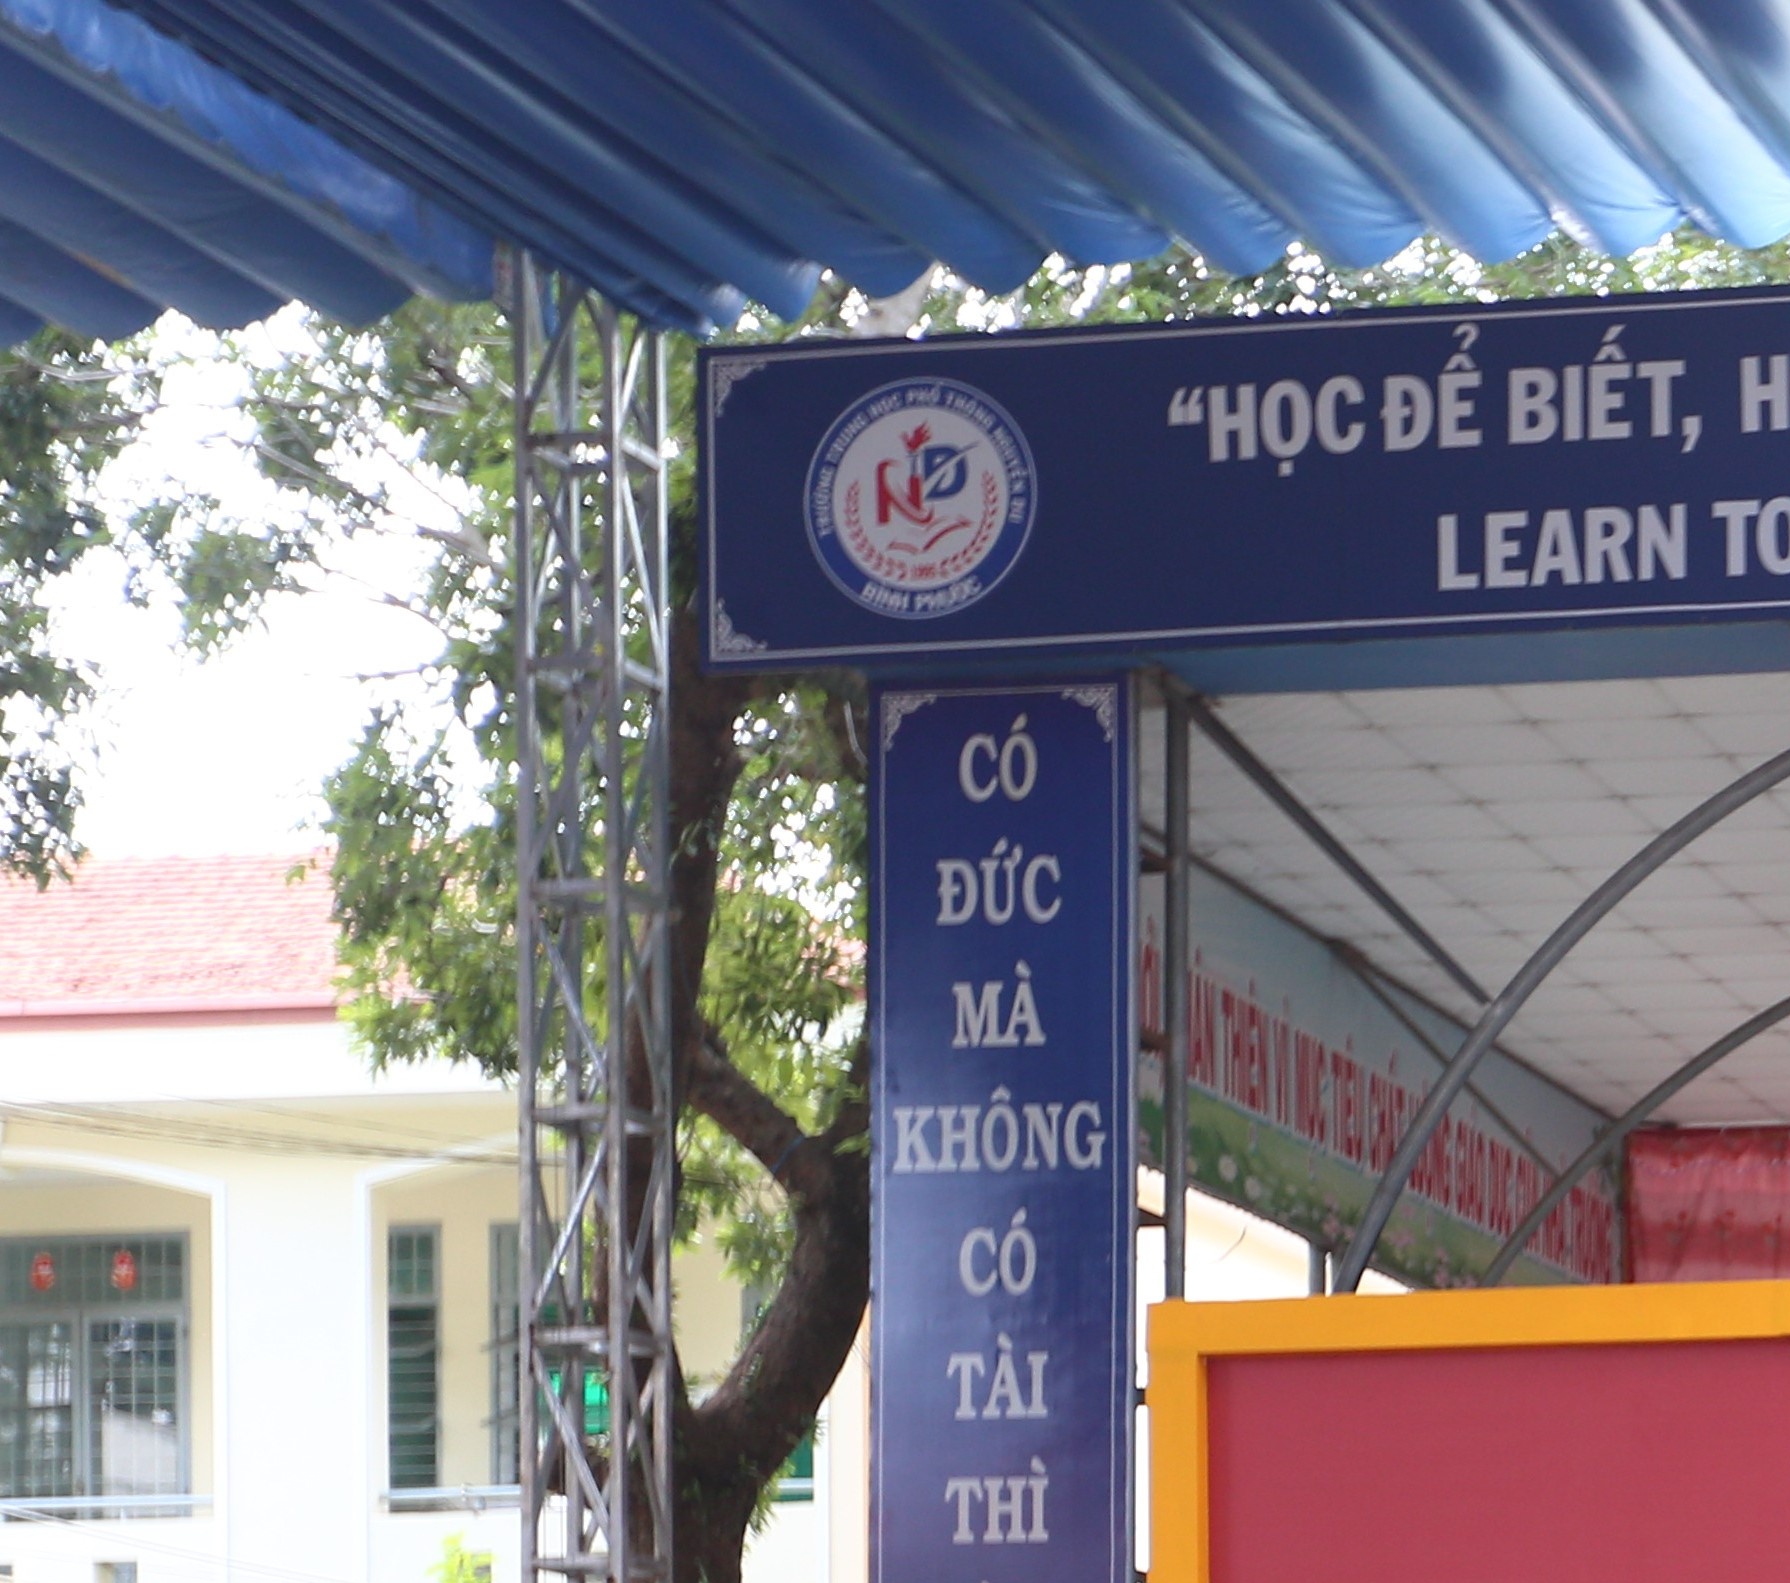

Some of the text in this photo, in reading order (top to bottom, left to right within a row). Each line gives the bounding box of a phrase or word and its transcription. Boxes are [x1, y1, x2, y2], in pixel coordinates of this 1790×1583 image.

[1168, 366, 1363, 476] “HỌC
[1384, 323, 1481, 452] ĐỂ
[1508, 326, 1699, 455] BIẾT,
[1439, 503, 1686, 594] LEARN
[959, 714, 1036, 801] CÓ
[936, 838, 1062, 925] ĐỨC
[952, 961, 1045, 1048] MÀ
[892, 1086, 1105, 1173] KHÔNG
[959, 1207, 1036, 1296] CÓ
[946, 1335, 1048, 1420] TÀI
[946, 1457, 1048, 1545] THÌ
